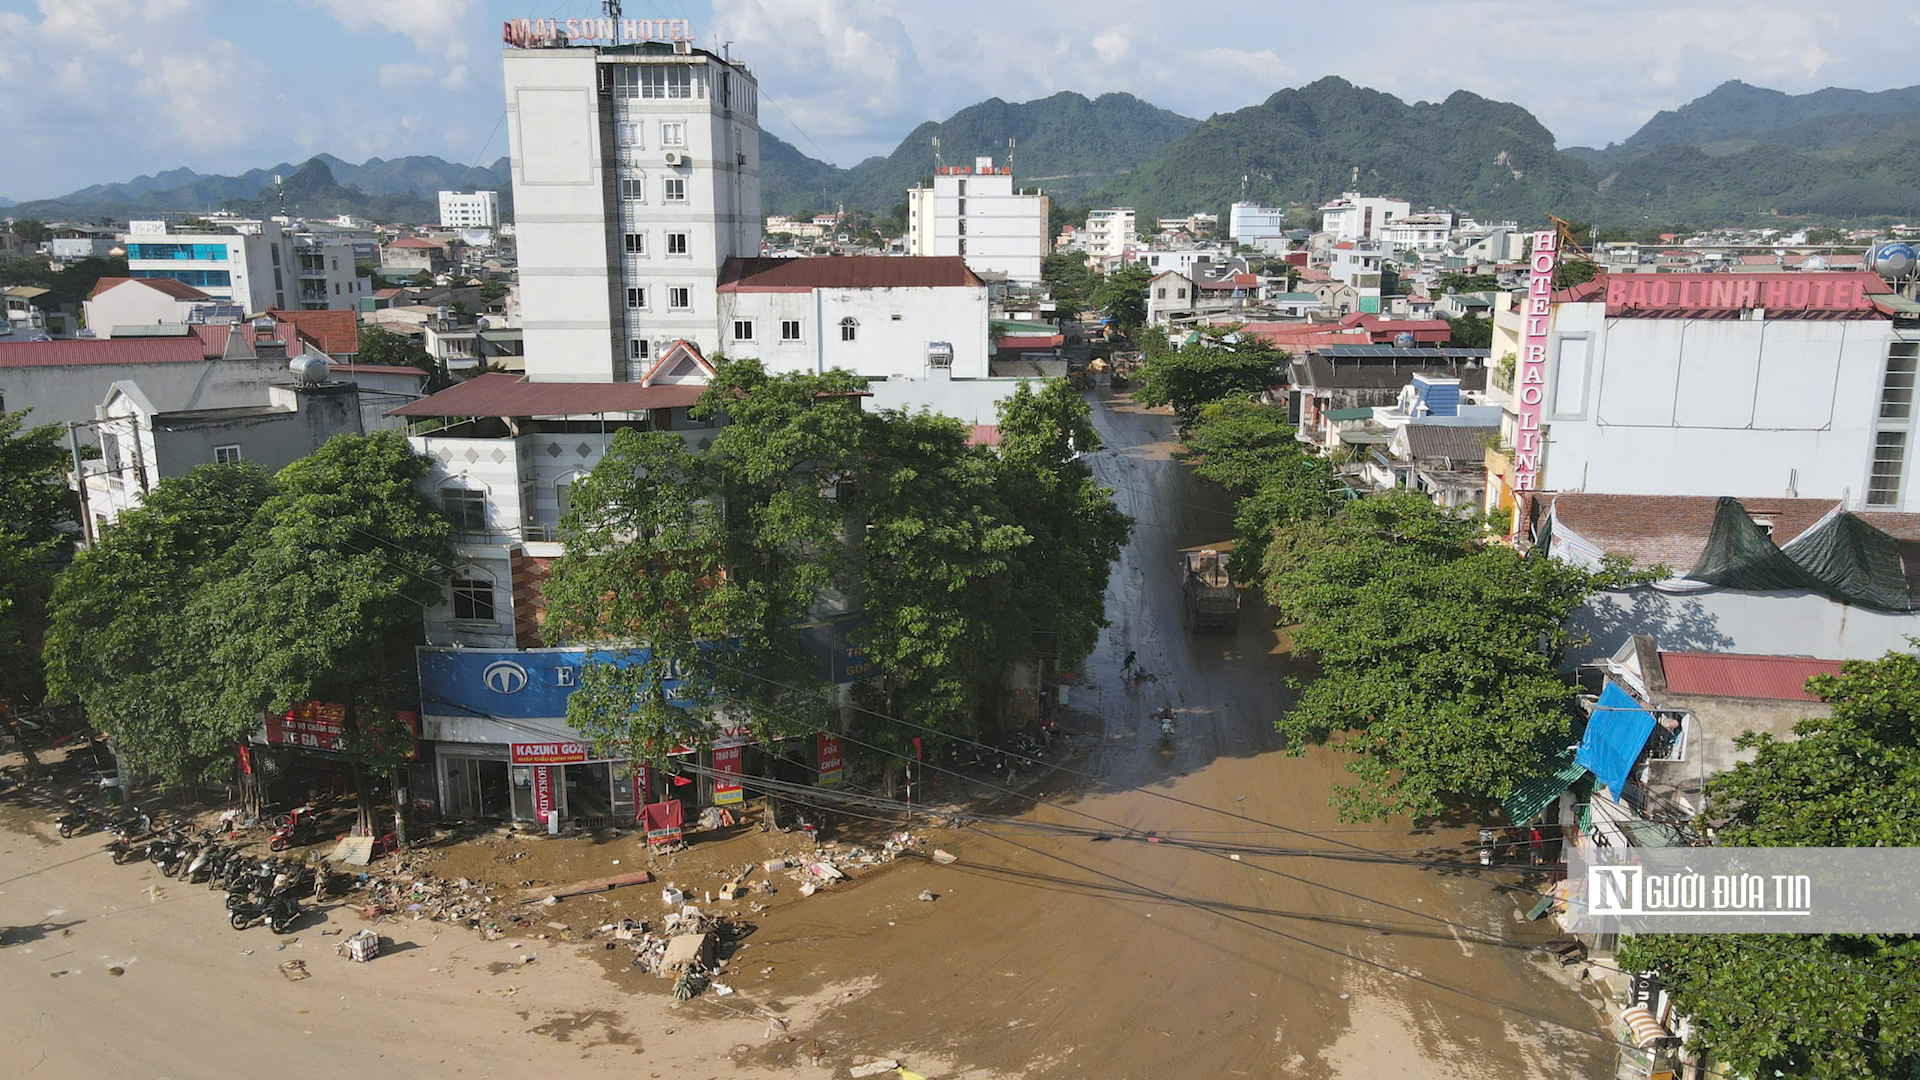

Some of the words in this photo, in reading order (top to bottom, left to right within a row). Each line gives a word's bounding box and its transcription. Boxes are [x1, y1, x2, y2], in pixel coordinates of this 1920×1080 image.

[510, 18, 557, 40] MAI
[565, 18, 614, 40] SON
[622, 18, 695, 41] HOTEL
[1528, 230, 1556, 337] HOTEL
[1607, 279, 1670, 308] BAO
[1679, 280, 1758, 309] LINH
[1766, 280, 1870, 310] HOTEL
[1520, 345, 1545, 406] BAO
[1514, 412, 1540, 490] LINH
[282, 731, 298, 745] XE
[301, 733, 319, 747] GA
[516, 743, 558, 756] KAZUKI
[538, 766, 549, 817] HOKKAIDO
